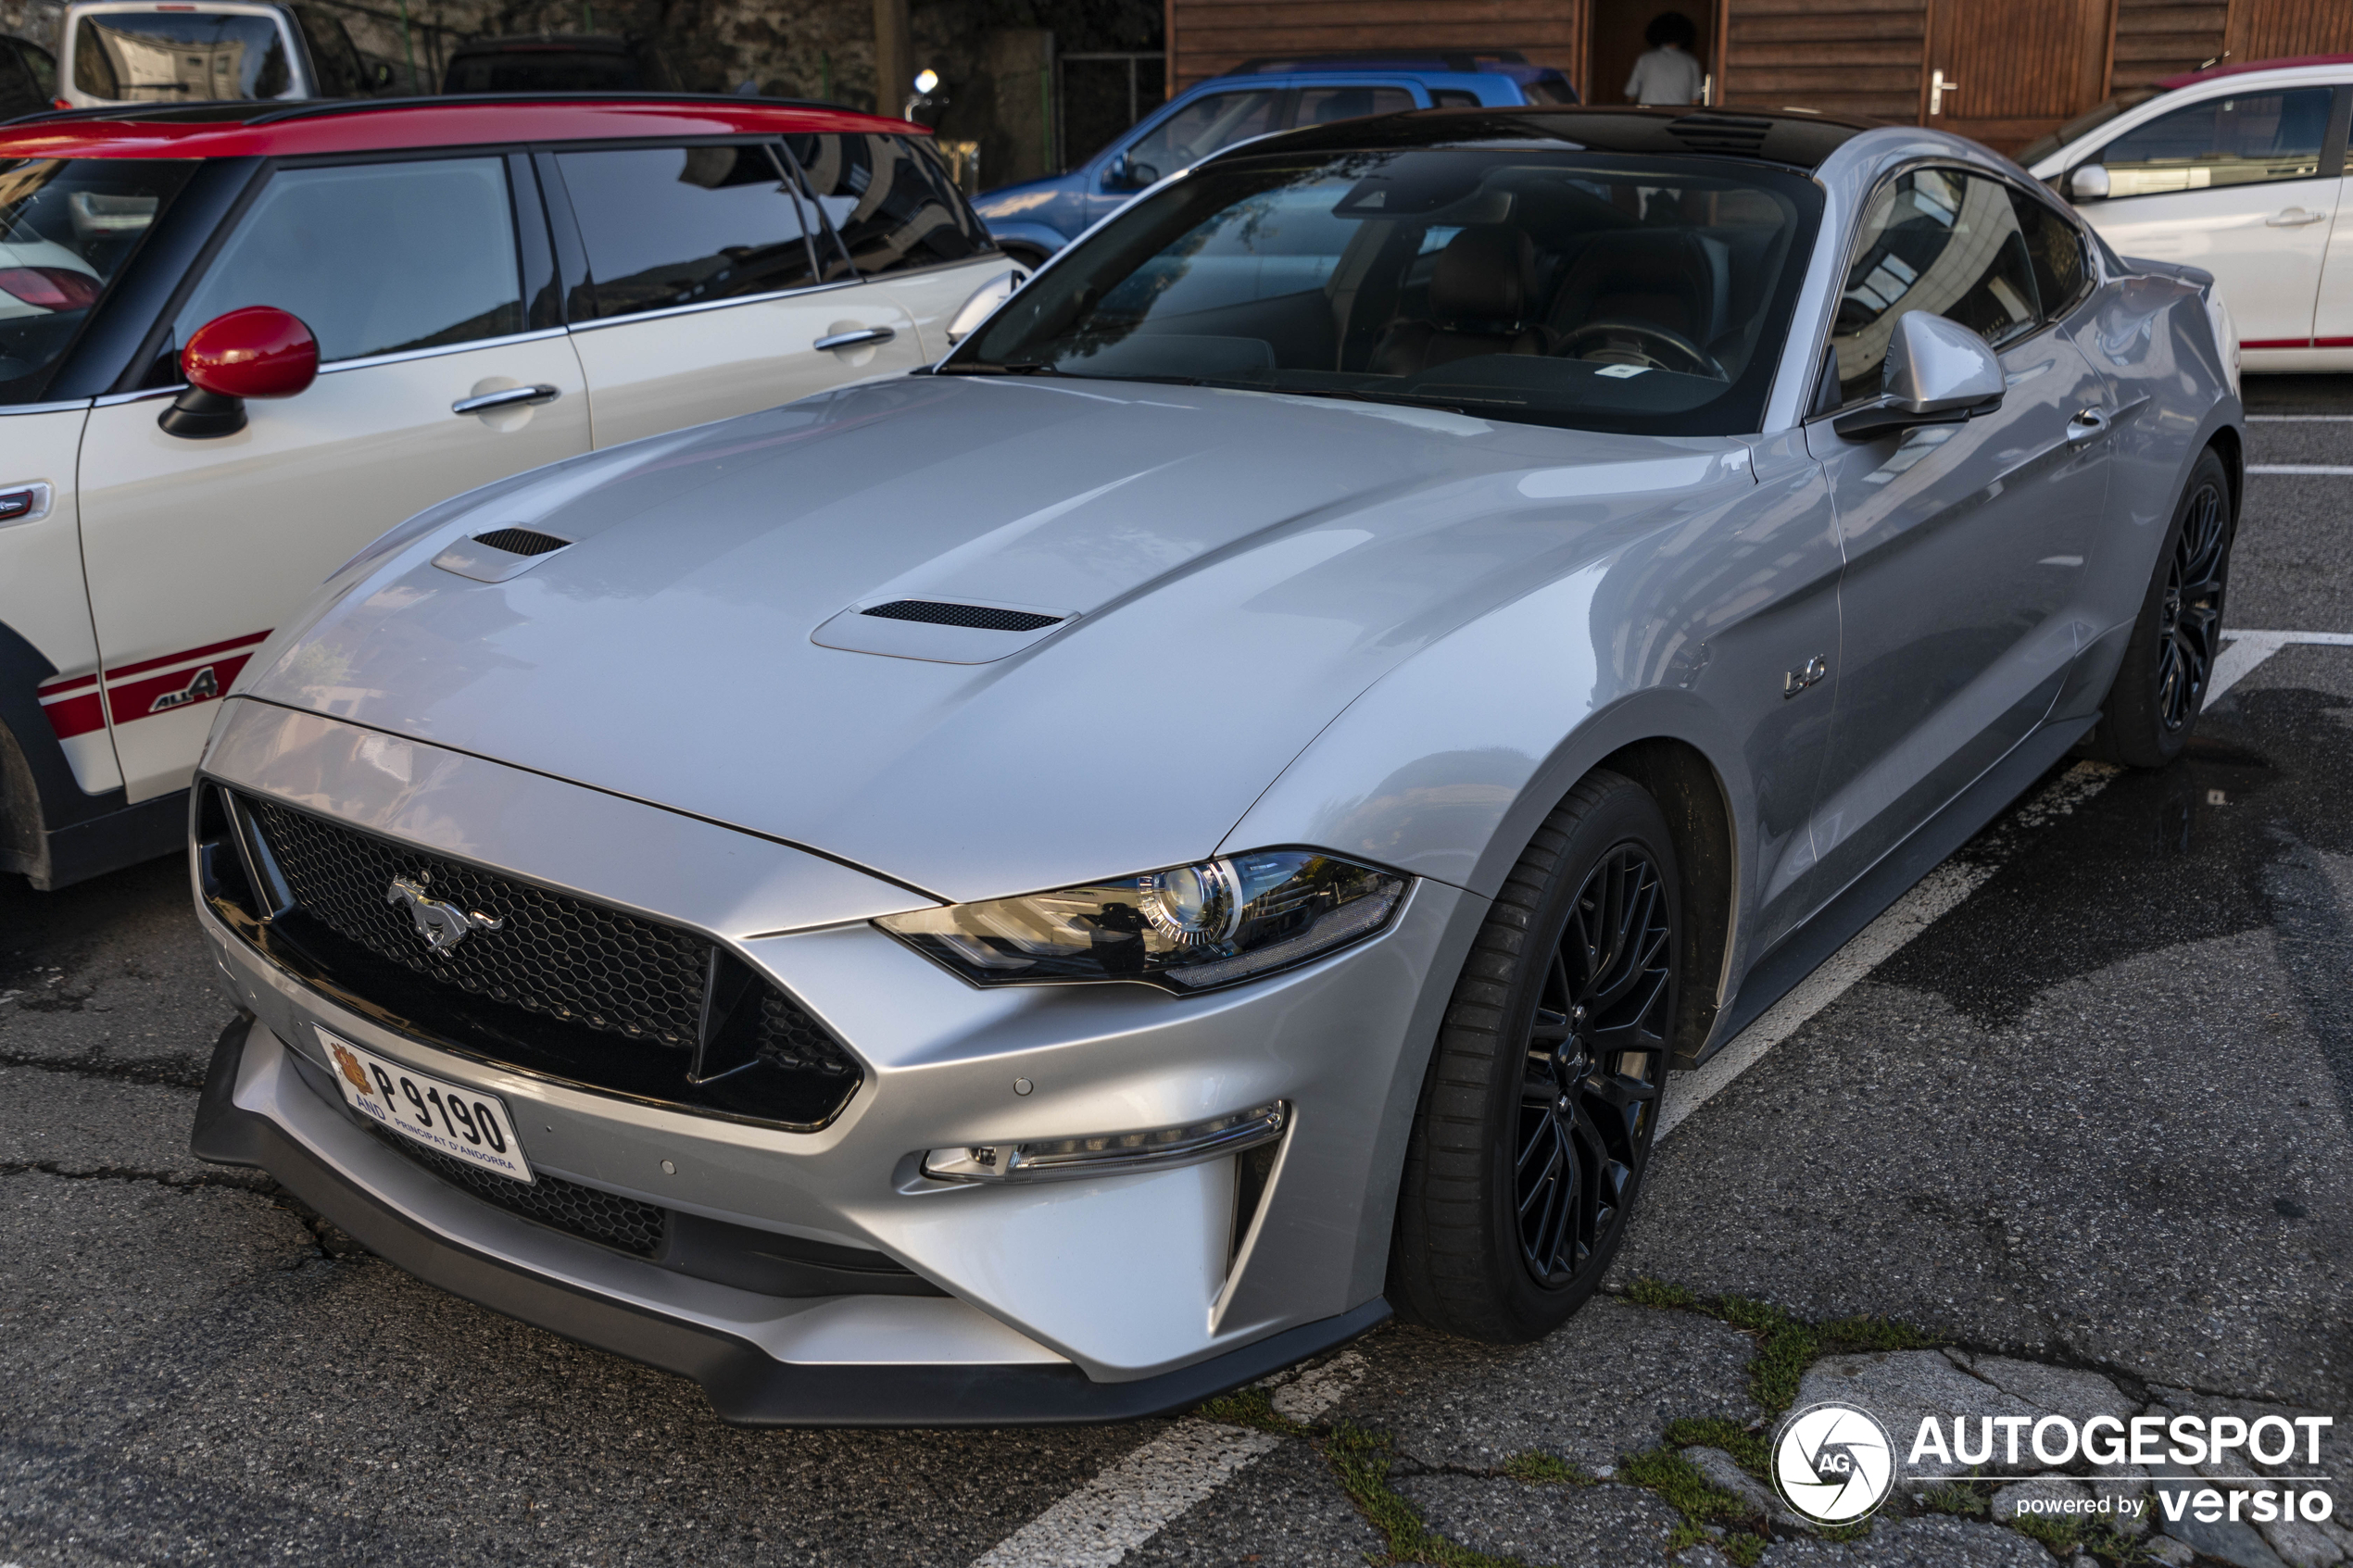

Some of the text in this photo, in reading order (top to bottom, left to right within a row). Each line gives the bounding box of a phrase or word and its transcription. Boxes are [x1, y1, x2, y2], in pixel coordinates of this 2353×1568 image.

[356, 1093, 386, 1121] AND
[369, 1061, 507, 1154] P 9190
[395, 1118, 517, 1172] PRINCIPAT D'ANDORRA
